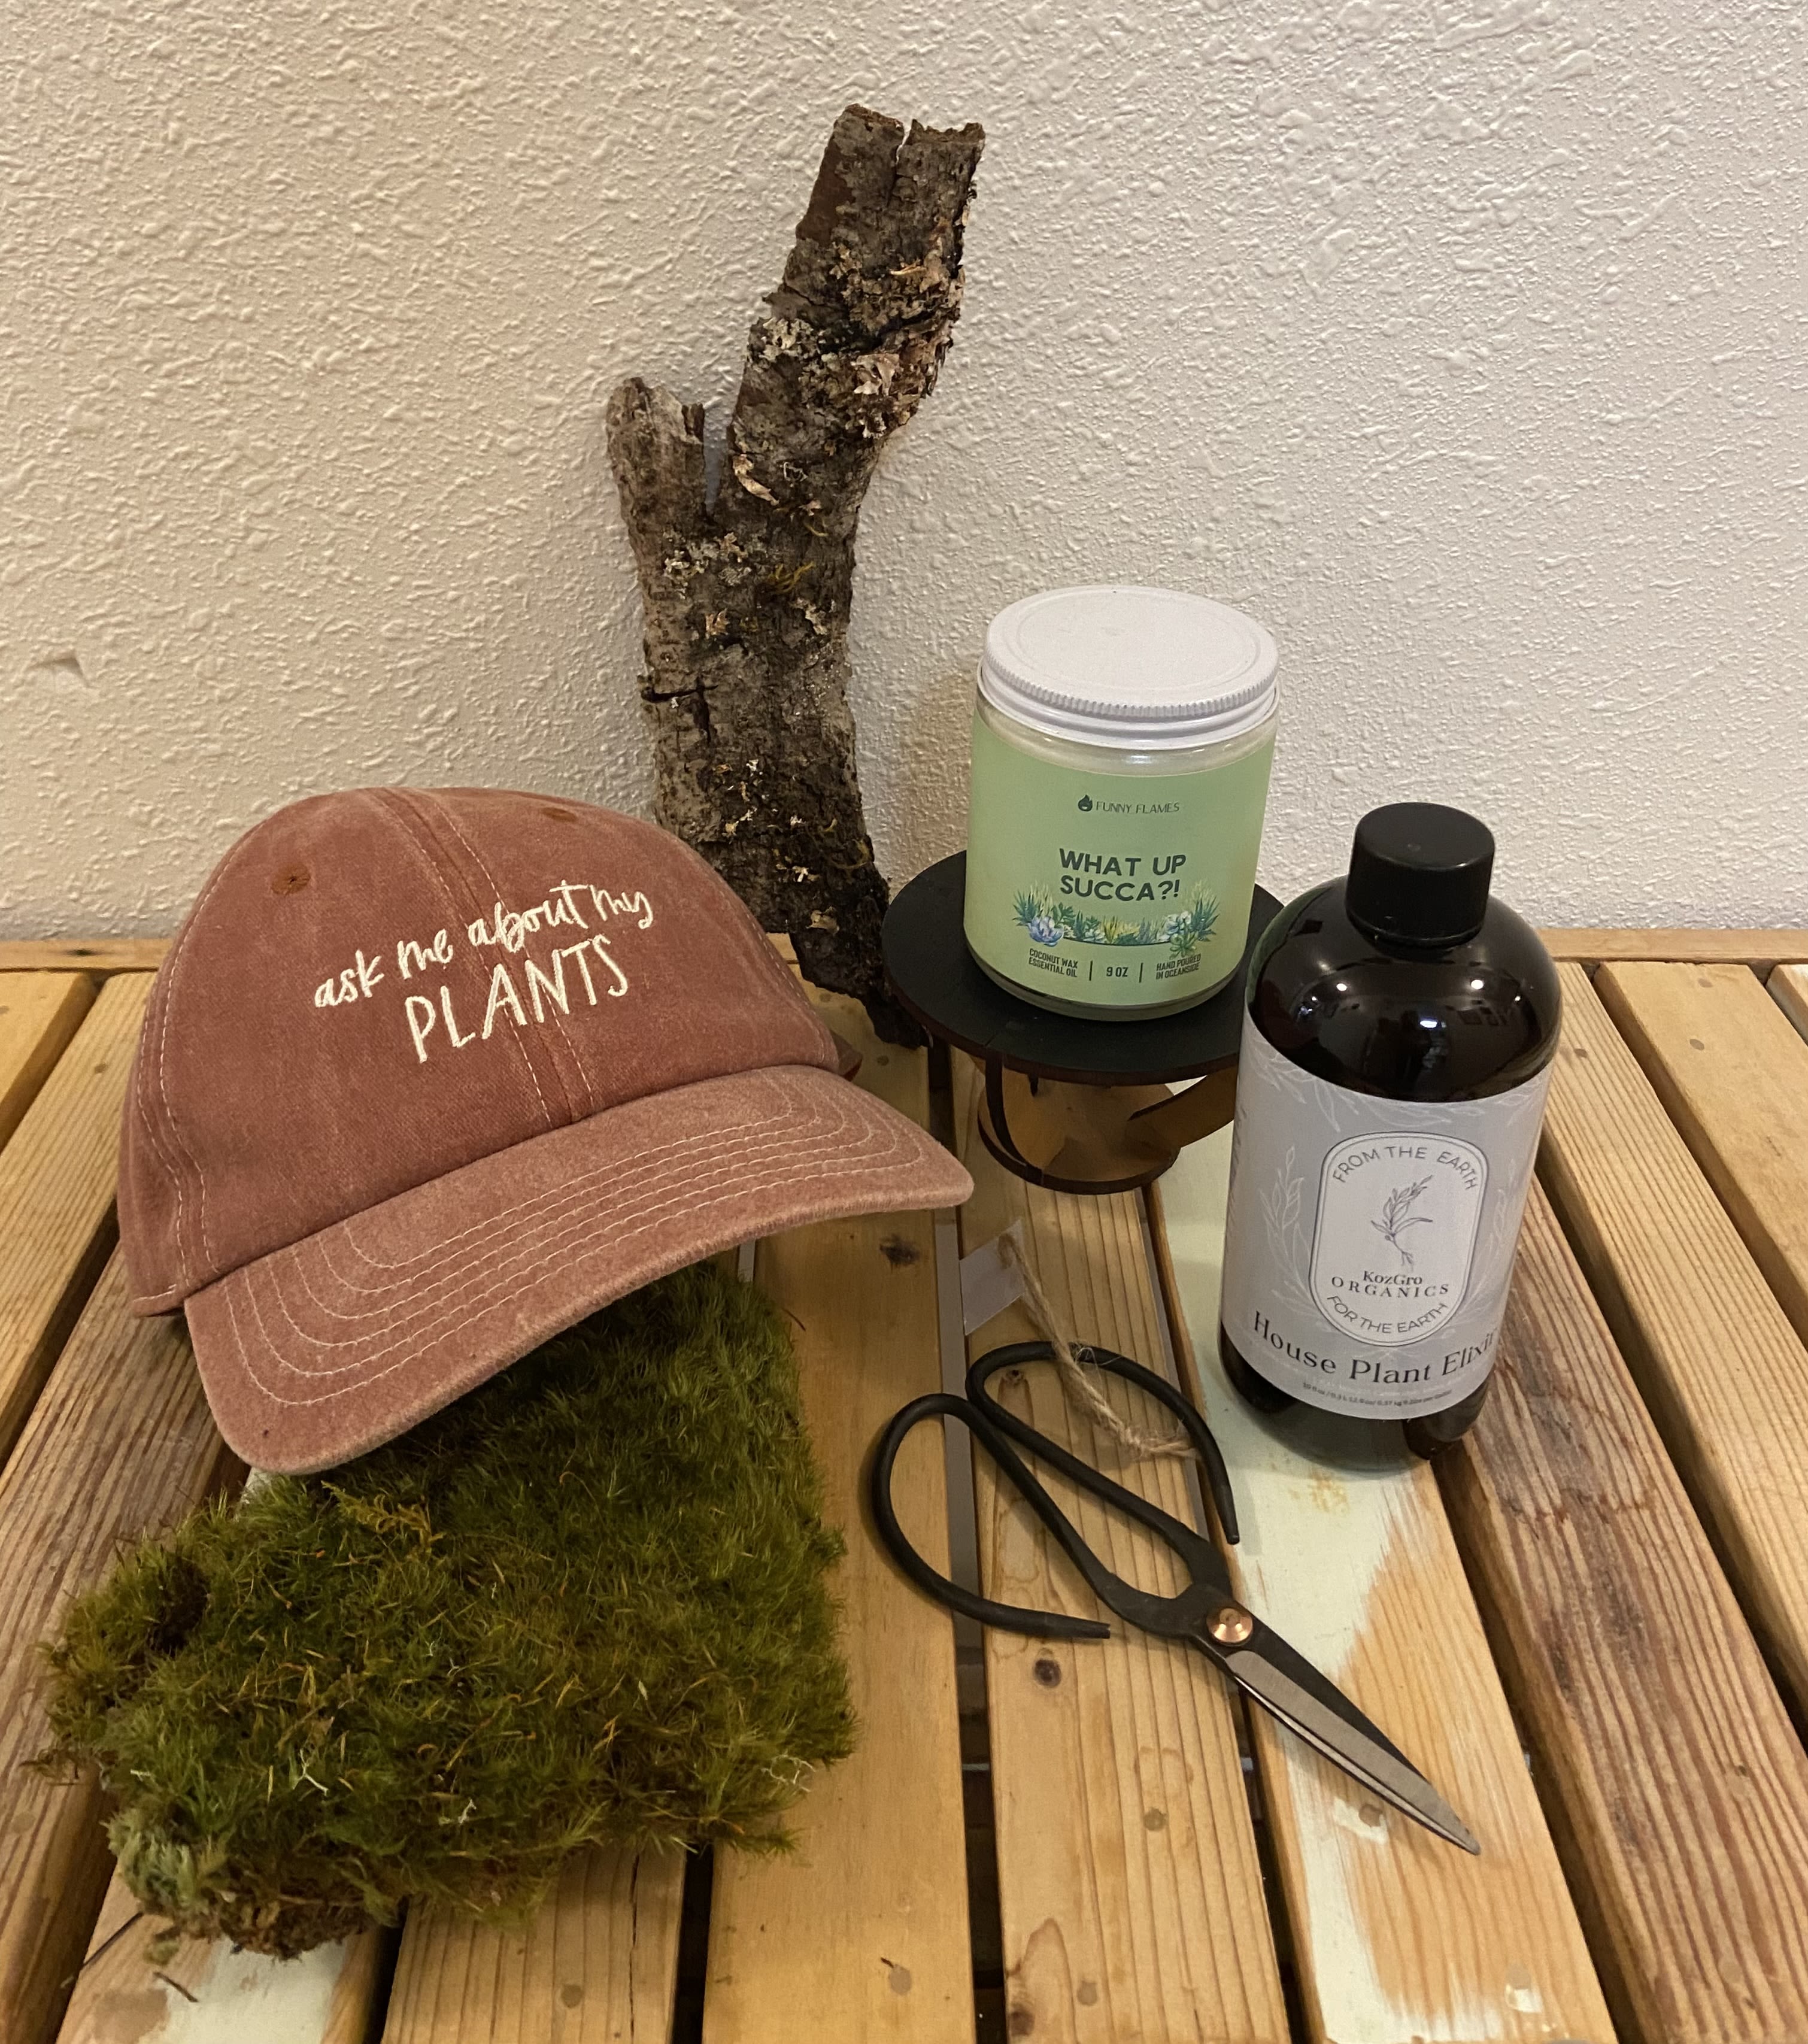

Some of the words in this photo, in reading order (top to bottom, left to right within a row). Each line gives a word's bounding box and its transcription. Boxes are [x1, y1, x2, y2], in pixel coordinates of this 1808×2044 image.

[1096, 801, 1132, 814] FUNNY
[1136, 802, 1180, 814] FLAMES
[1059, 848, 1141, 877] WHAT
[1152, 854, 1186, 875] UP
[1060, 875, 1180, 901] SUCCA?!
[314, 950, 384, 1007] ask
[398, 929, 453, 979] me
[468, 880, 588, 953] about
[588, 884, 654, 929] my
[1029, 948, 1060, 965] COCONUT
[1061, 957, 1078, 969] WAX
[1029, 957, 1064, 975] ESSENTIAL
[1066, 968, 1078, 977] OIL
[1156, 960, 1176, 971] HAND
[1176, 953, 1201, 968] POURED
[1106, 966, 1113, 977] 9
[1115, 966, 1129, 977] OZ
[1156, 971, 1163, 979] IN
[1164, 962, 1200, 978] OCEANSIDE
[405, 934, 628, 1063] PLANTS
[1333, 1148, 1381, 1183] FROM
[1384, 1146, 1428, 1159] THE
[1437, 1151, 1478, 1190] EARTH
[1331, 1276, 1449, 1298] ORGANICS
[1363, 1270, 1423, 1285] KozGro
[1327, 1296, 1358, 1322] FOR
[1360, 1317, 1393, 1333] THE
[1397, 1302, 1448, 1333] EARTH
[1254, 1311, 1336, 1374] House
[1349, 1358, 1431, 1384] Plant
[1442, 1327, 1497, 1376] Elixir
